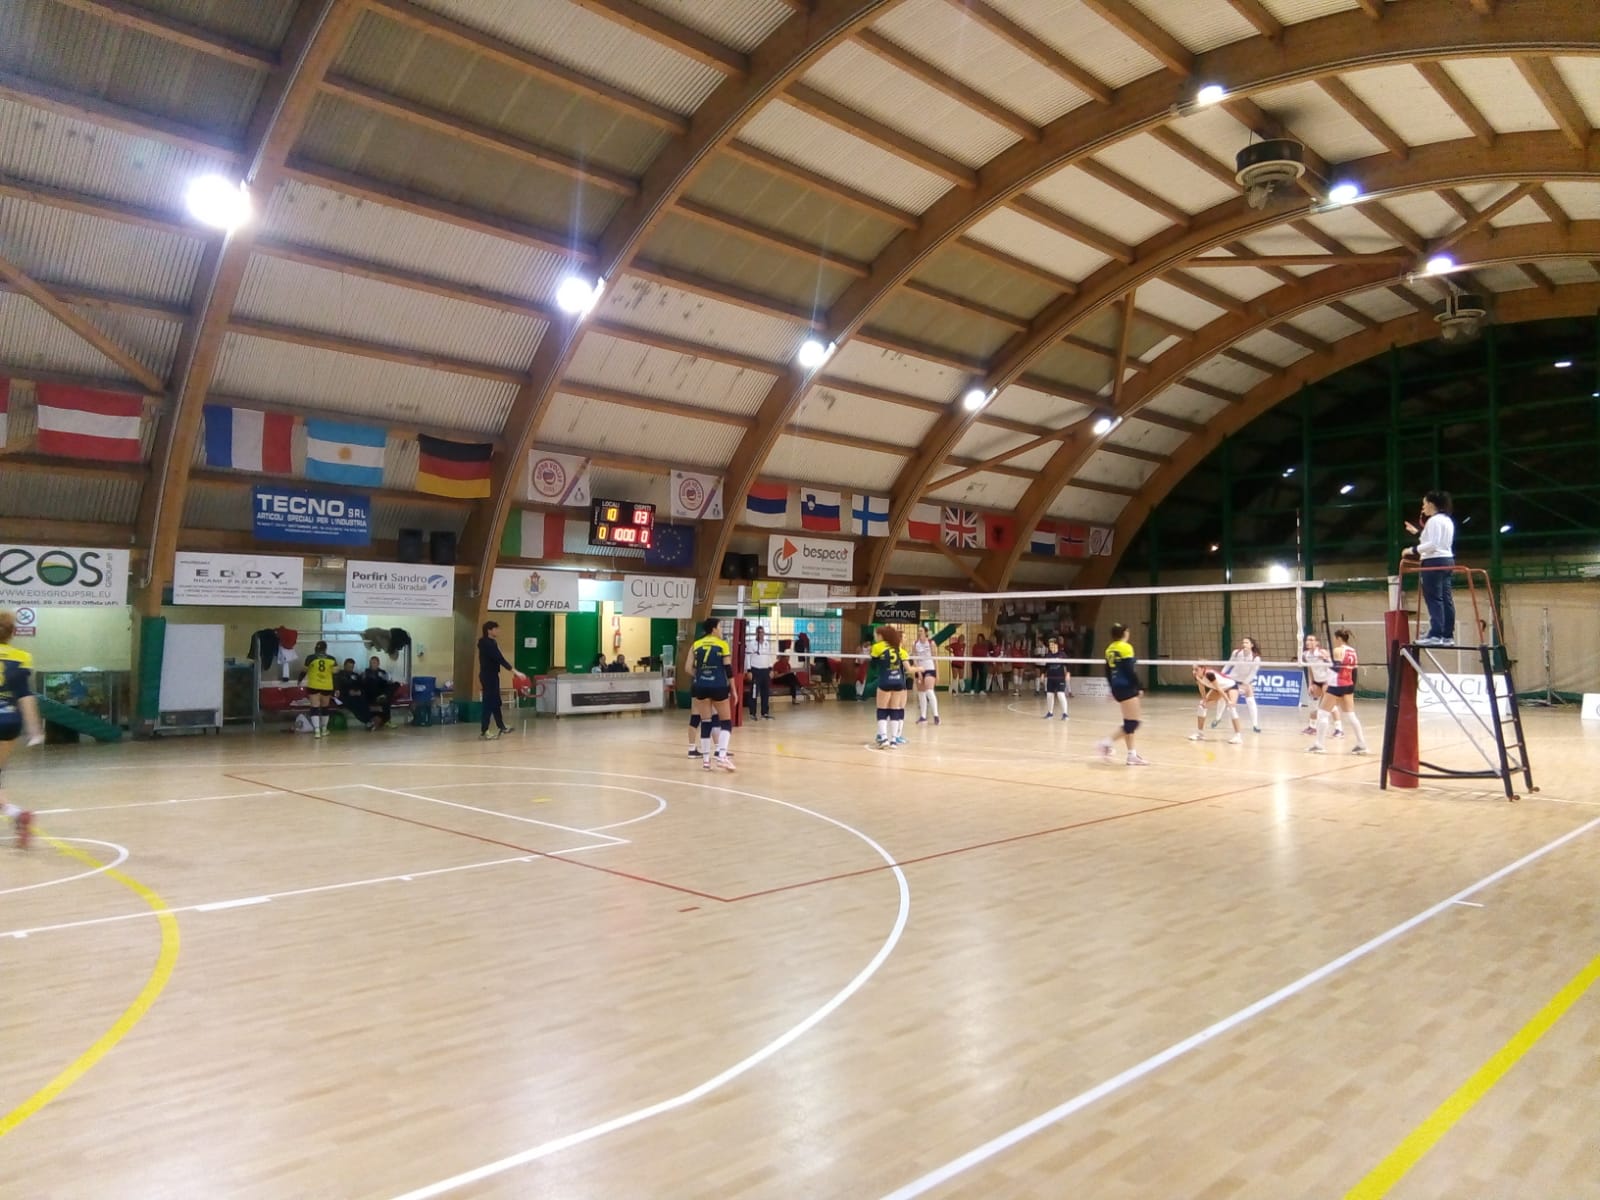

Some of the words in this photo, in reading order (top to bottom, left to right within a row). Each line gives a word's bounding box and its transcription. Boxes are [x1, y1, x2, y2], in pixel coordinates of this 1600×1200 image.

[256, 493, 345, 517] TECNO
[347, 508, 367, 519] SRL
[256, 511, 284, 521] ARTICOLI
[286, 513, 315, 524] SPECIALI
[316, 516, 329, 525] PER
[330, 518, 368, 528] L'INDUSTRIA
[633, 511, 648, 525] 03
[598, 527, 608, 541] 0
[803, 543, 849, 561] bespeco
[352, 571, 388, 581] Porfiri
[391, 573, 428, 584] Sandro
[351, 582, 377, 590] Lavori
[379, 583, 397, 591] Edili
[398, 584, 428, 592] Stradali
[630, 578, 661, 599] CIÙ
[663, 580, 691, 599] CIÙ
[495, 597, 522, 609] CITTÀ
[524, 600, 534, 609] DI
[536, 600, 570, 610] OFFIDA
[702, 645, 712, 663] 7
[889, 648, 898, 663] 5
[318, 660, 326, 672] 8
